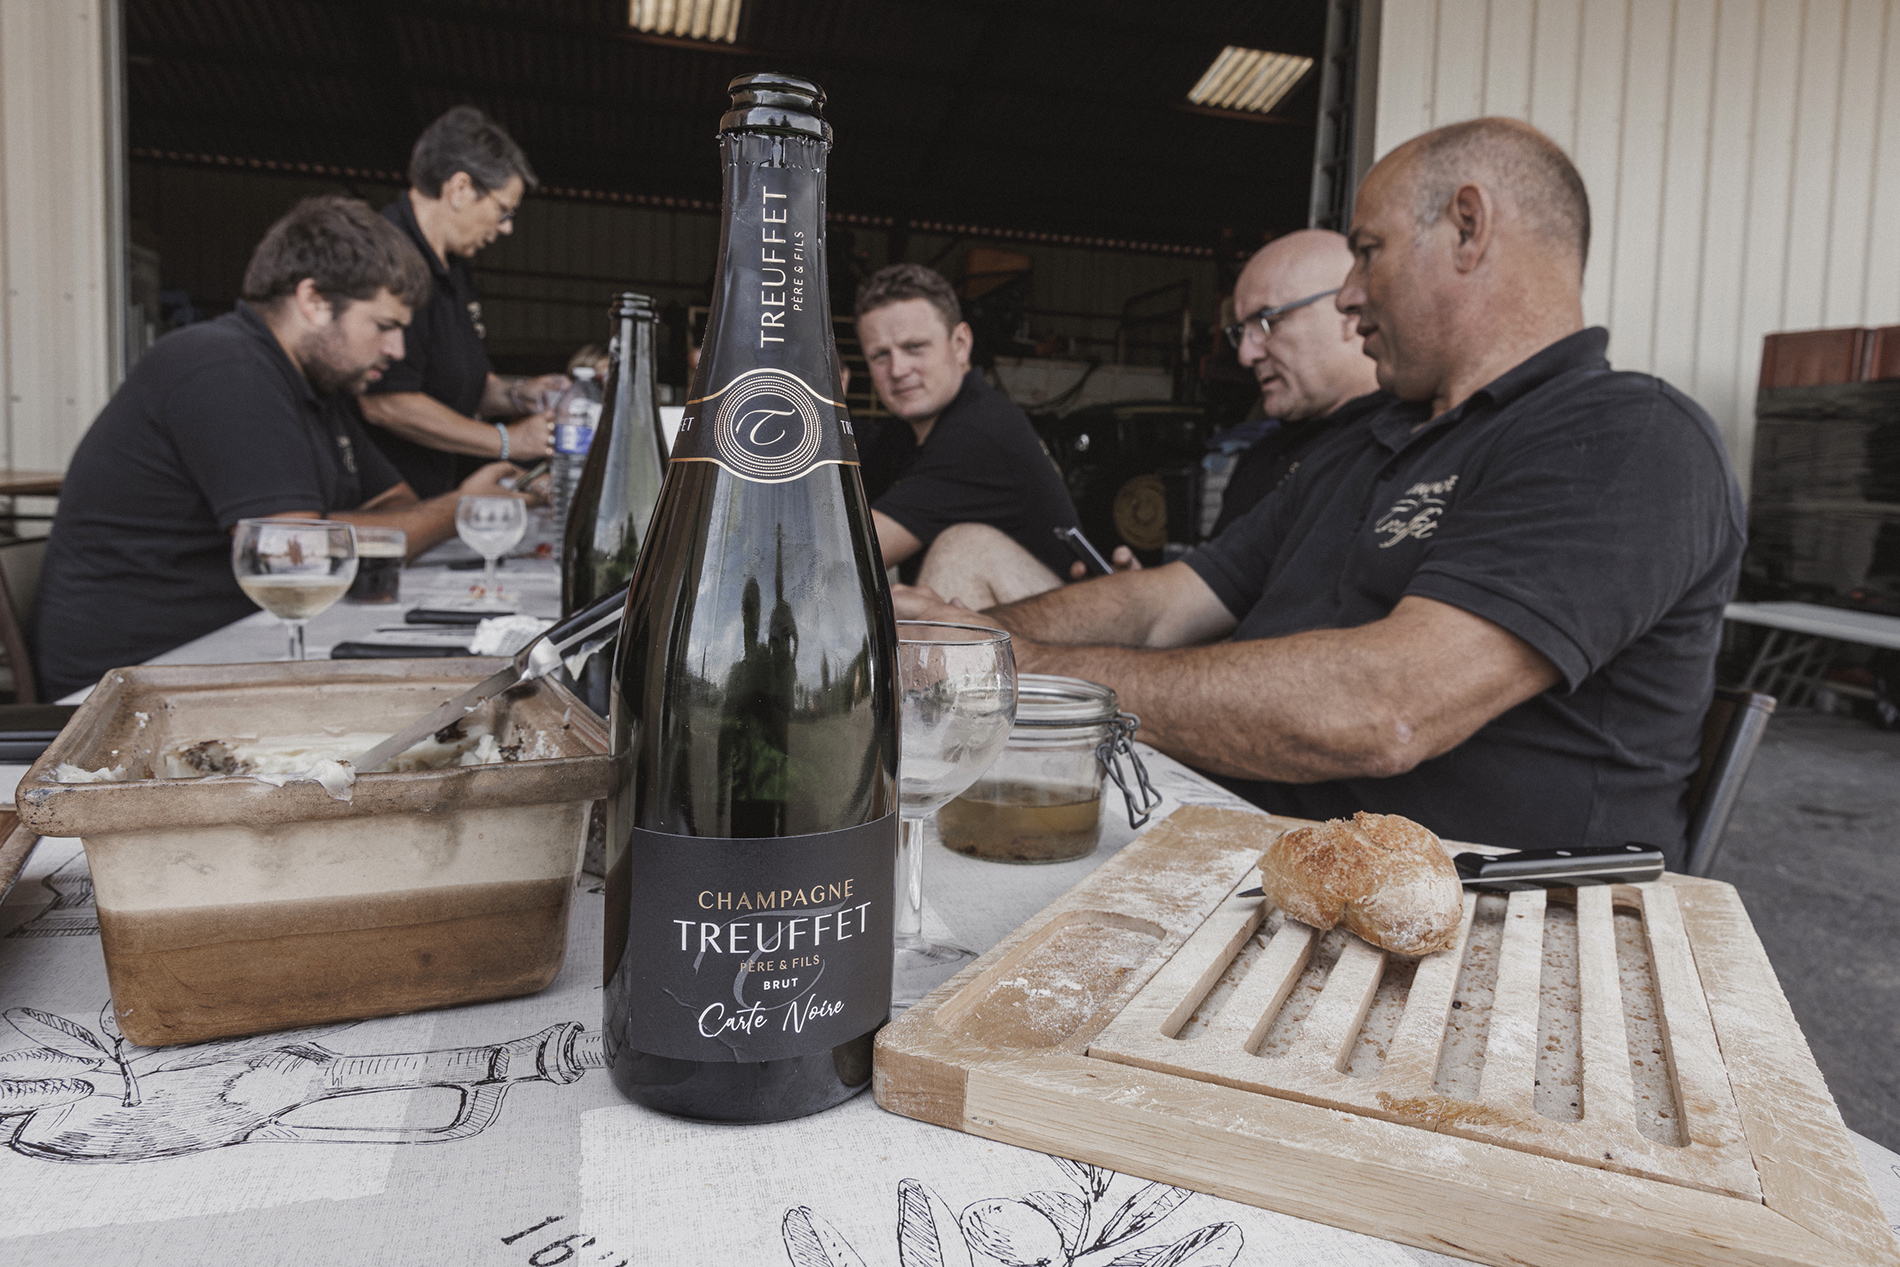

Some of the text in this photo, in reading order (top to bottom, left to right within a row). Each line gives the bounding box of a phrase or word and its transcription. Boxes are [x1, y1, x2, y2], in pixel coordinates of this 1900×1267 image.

[760, 185, 787, 348] TREUFFET
[790, 231, 805, 312] PÈRE & FILS
[698, 878, 854, 910] CHAMPAGNE
[673, 901, 871, 954] TREUFFET
[739, 954, 820, 973] PÈRE & FILS
[763, 977, 799, 990] BRUT
[698, 993, 845, 1038] Carte Noire
